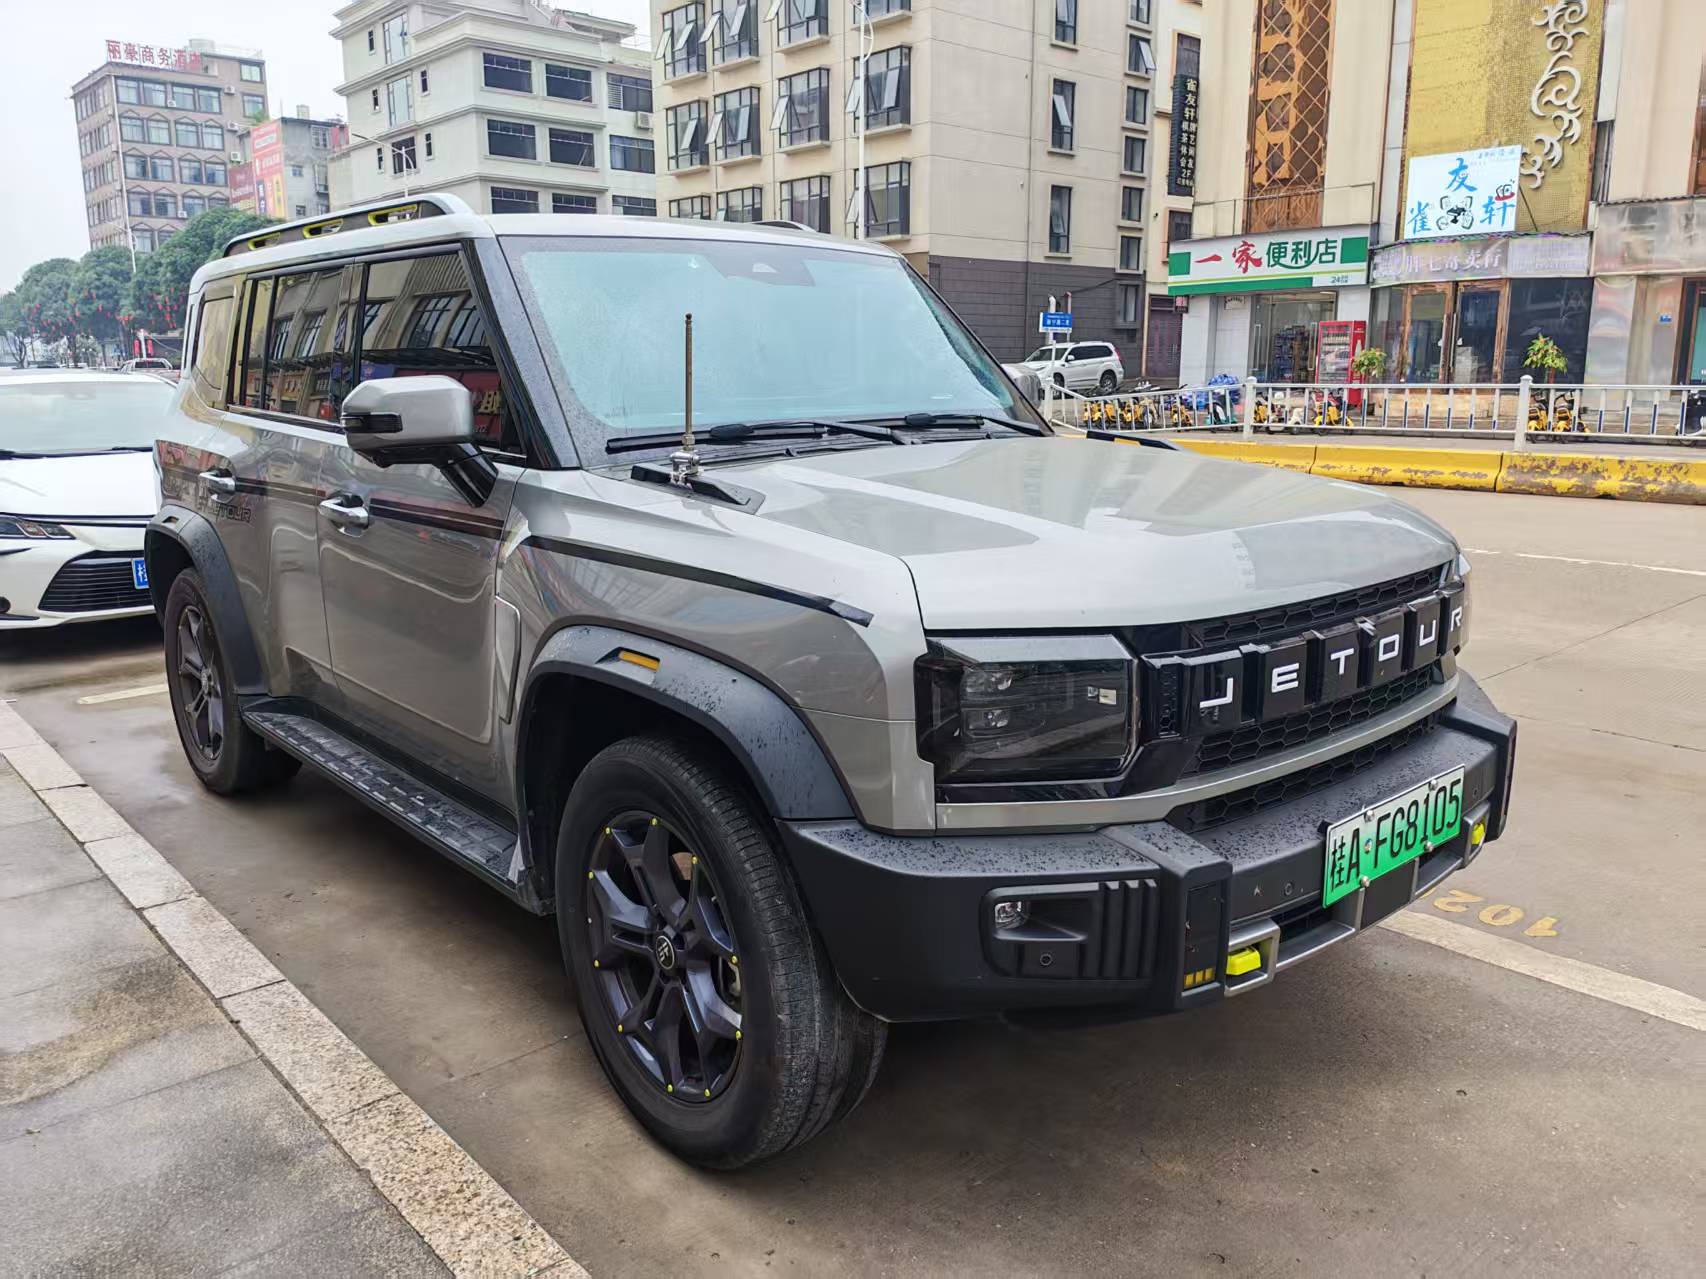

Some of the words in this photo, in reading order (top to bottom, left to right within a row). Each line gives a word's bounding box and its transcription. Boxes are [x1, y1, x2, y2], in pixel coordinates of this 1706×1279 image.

[1184, 79, 1198, 120] 雀友轩
[1194, 237, 1338, 274] 一家便利店
[1199, 606, 1463, 709] JETOUR
[1420, 887, 1559, 938] 102
